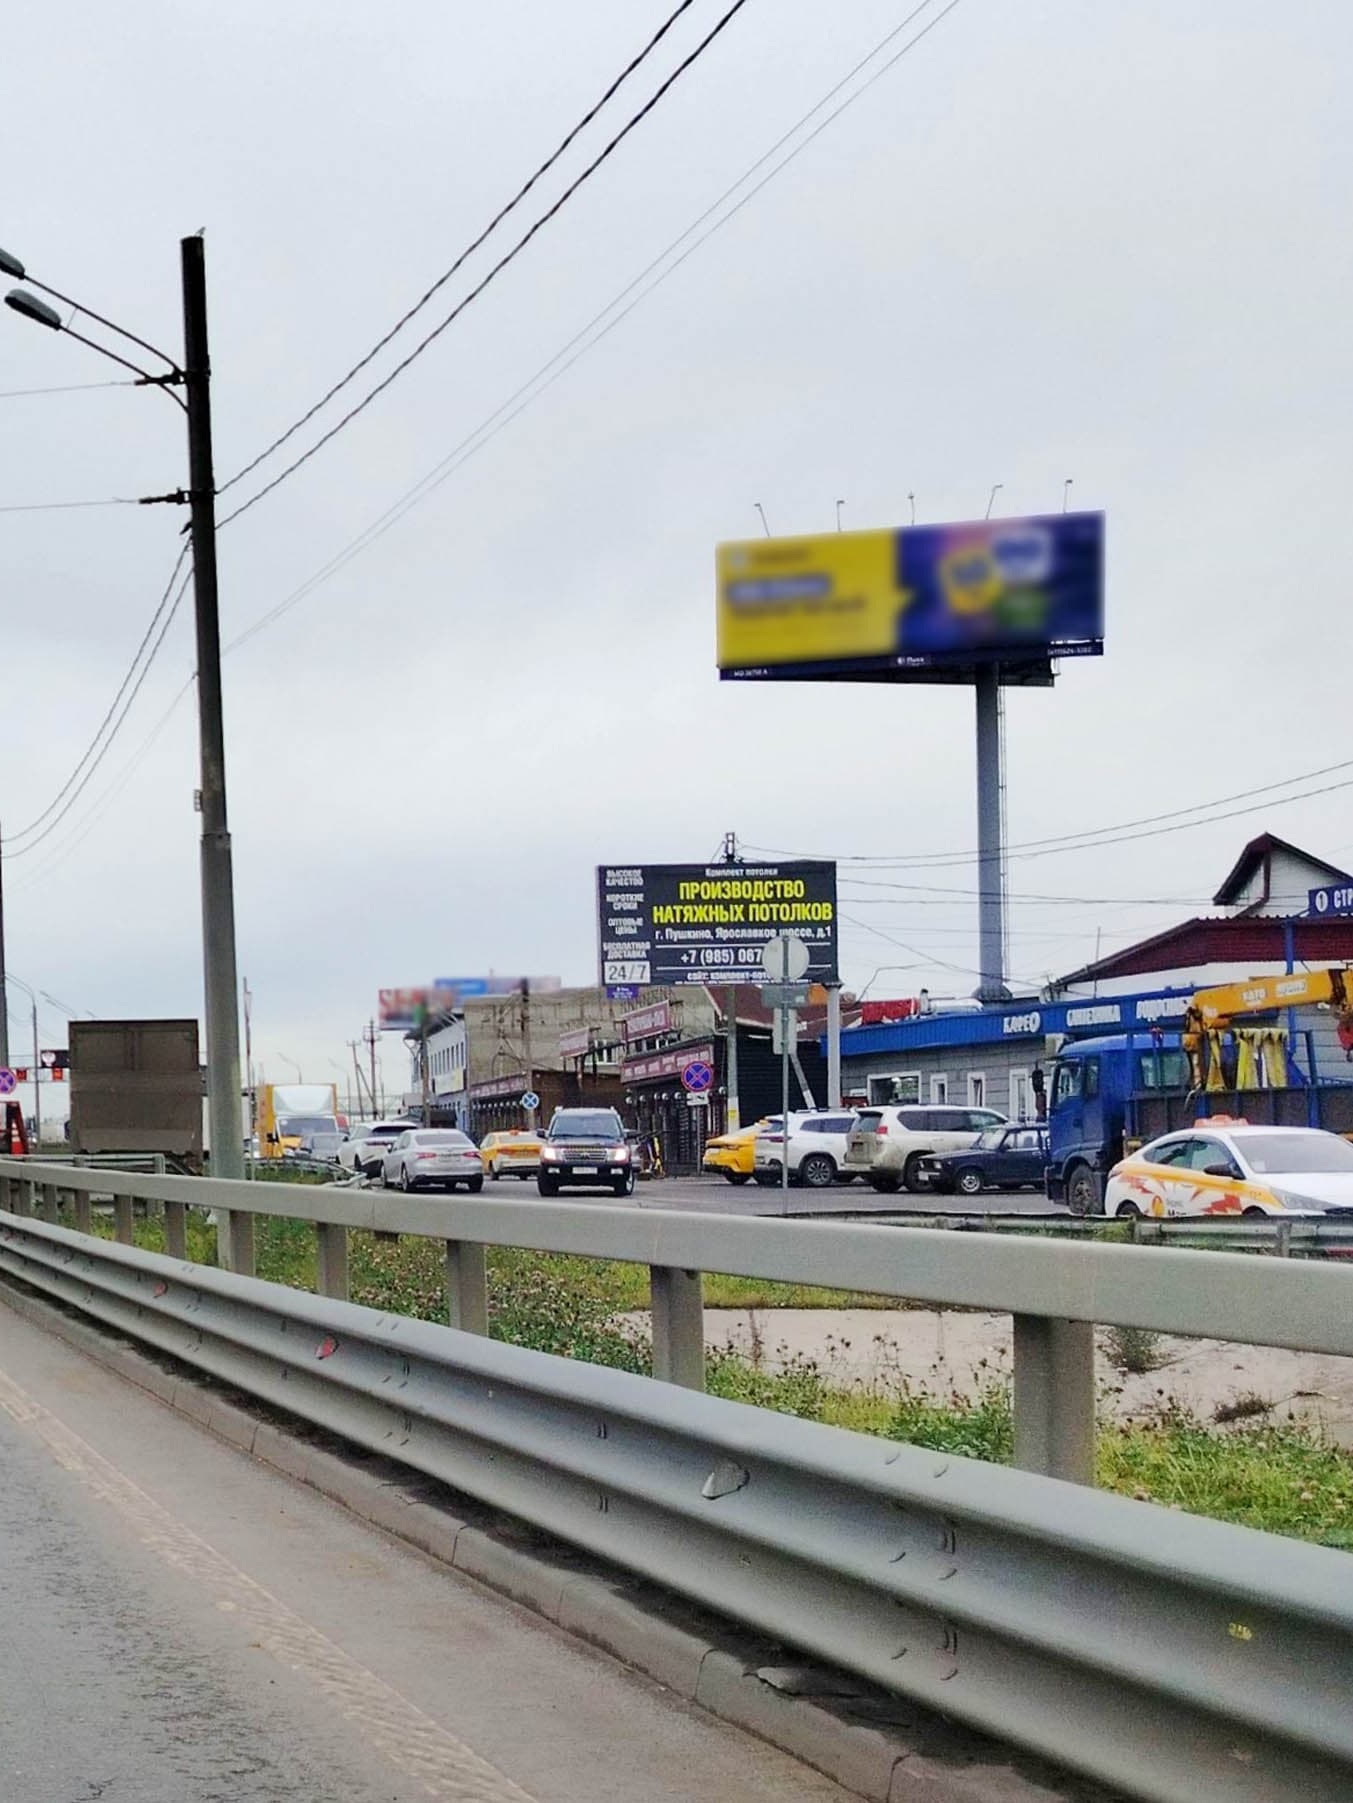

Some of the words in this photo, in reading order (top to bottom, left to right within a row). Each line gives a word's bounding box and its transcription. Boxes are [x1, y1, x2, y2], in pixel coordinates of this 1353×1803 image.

[679, 880, 805, 901] ПРОИЗВОДСТВО
[652, 904, 745, 924] НАТЯЖНЫХ
[748, 902, 833, 922] ПОТОЛКОВ
[655, 930, 664, 940] г.
[665, 927, 714, 942] Пушкино,
[680, 949, 697, 964] +7
[700, 949, 735, 966] (985)
